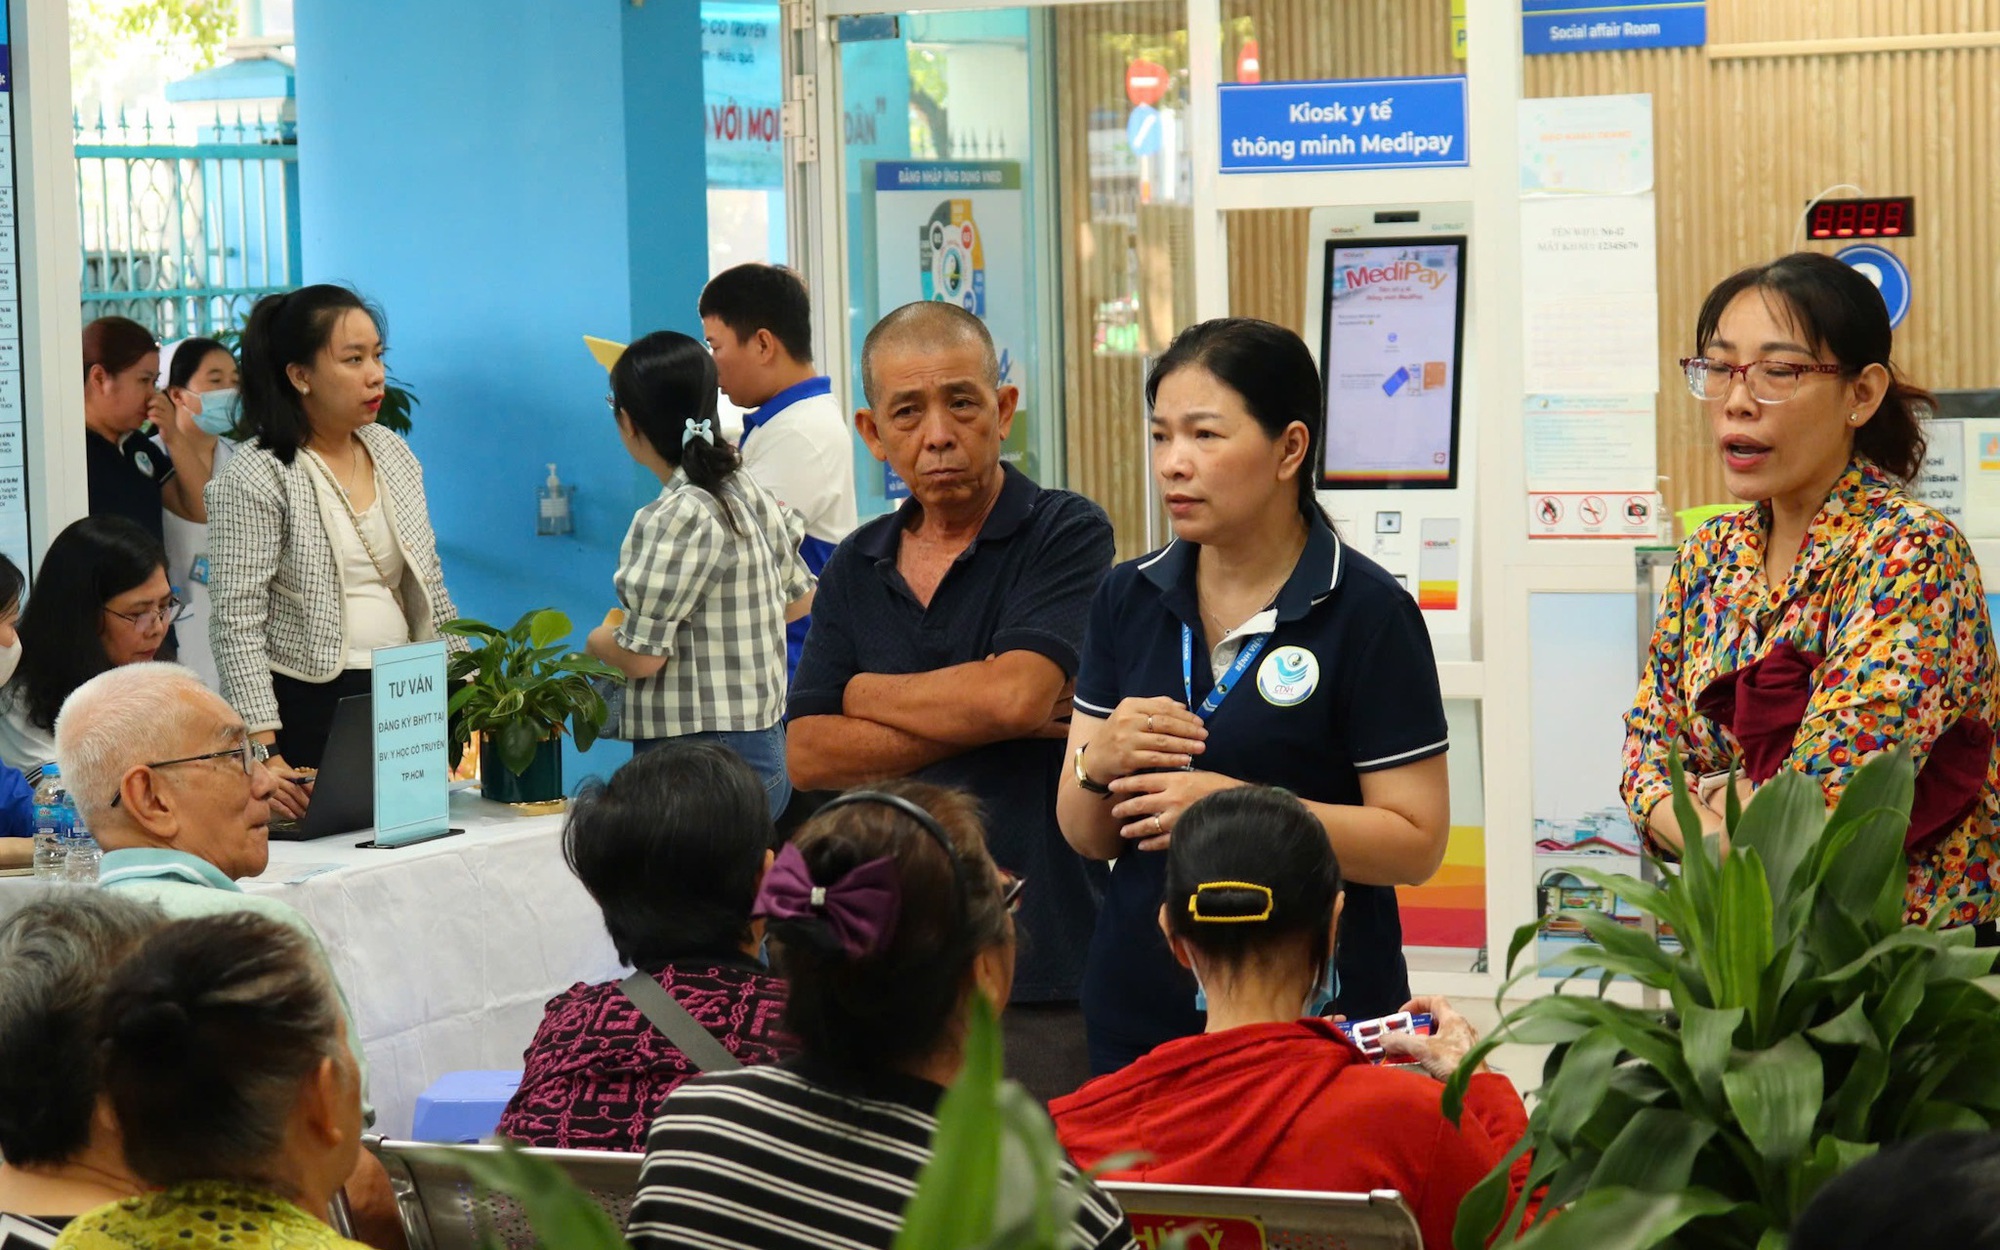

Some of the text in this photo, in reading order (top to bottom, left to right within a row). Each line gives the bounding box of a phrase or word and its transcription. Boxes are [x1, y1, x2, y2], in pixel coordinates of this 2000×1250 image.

[1549, 22, 1661, 41] Social affair Room
[1289, 97, 1395, 126] Kiosk y tế
[1232, 130, 1454, 160] thông minh Medipay
[1346, 260, 1448, 291] MediPay
[1235, 651, 1252, 672] BỆNH
[388, 673, 432, 698] TƯ VẤN
[378, 711, 444, 733] ĐĂNG KÝ BHYT TẠI
[379, 752, 390, 762] BV.
[391, 750, 395, 758] Y
[396, 748, 410, 759] HỌC
[402, 769, 424, 781] TP.HCM
